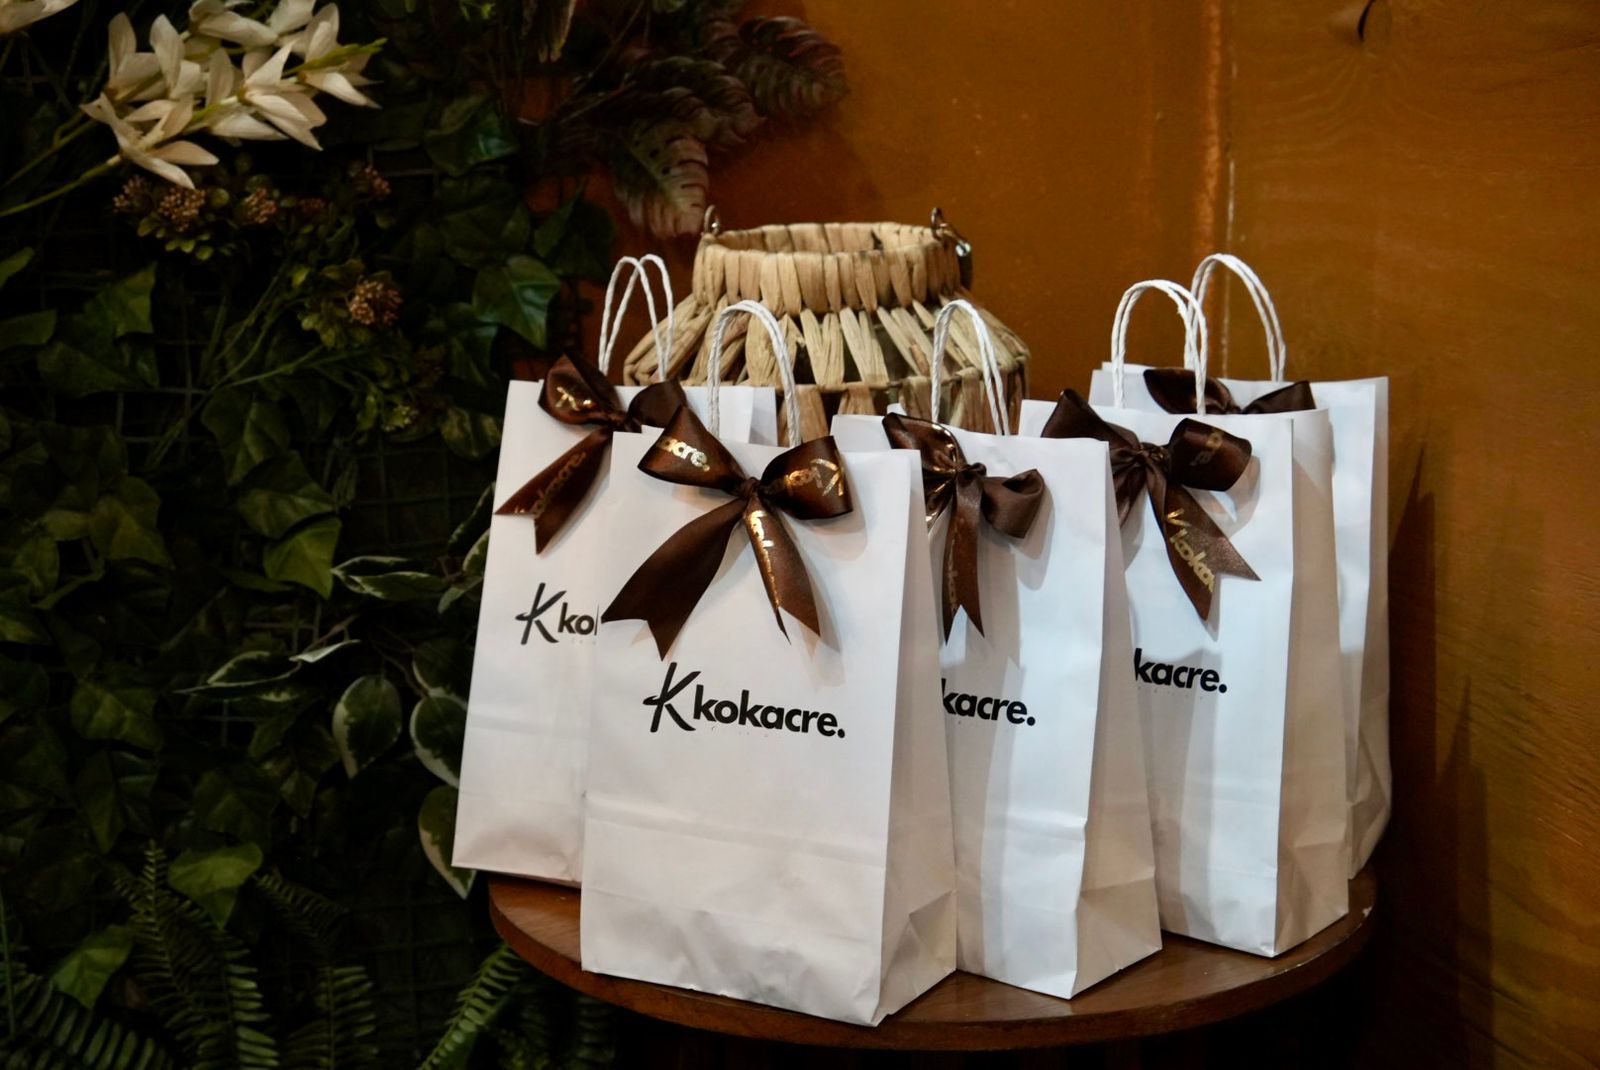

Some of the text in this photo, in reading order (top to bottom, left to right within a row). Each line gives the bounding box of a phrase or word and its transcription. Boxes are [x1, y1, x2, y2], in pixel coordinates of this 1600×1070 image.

[558, 602, 600, 636] ko
[1134, 647, 1227, 694] kacre.
[692, 683, 846, 739] kokacre.
[941, 678, 1036, 727] kacre.
